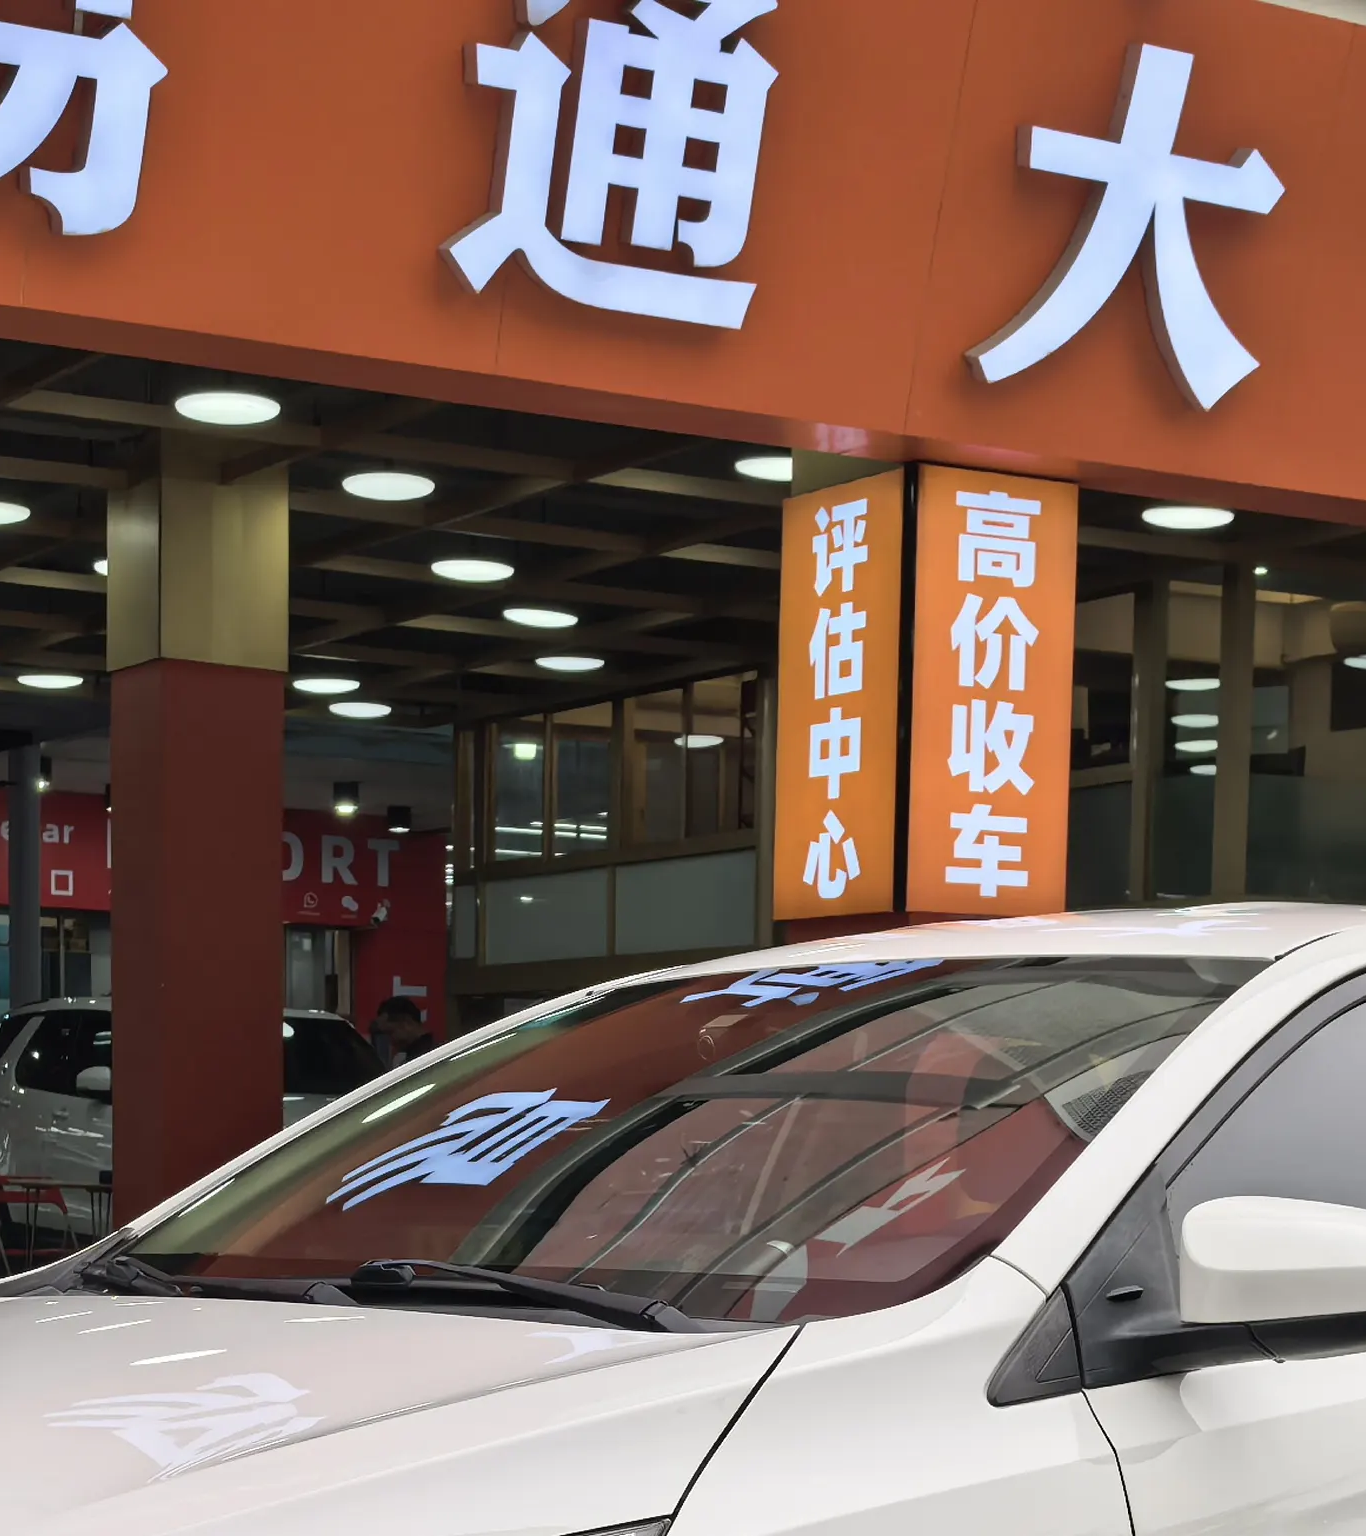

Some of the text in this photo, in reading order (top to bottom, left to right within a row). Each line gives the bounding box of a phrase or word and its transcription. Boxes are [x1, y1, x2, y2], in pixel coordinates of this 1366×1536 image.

[803, 498, 869, 899] 评估中心
[945, 490, 1041, 897] 高价收车
